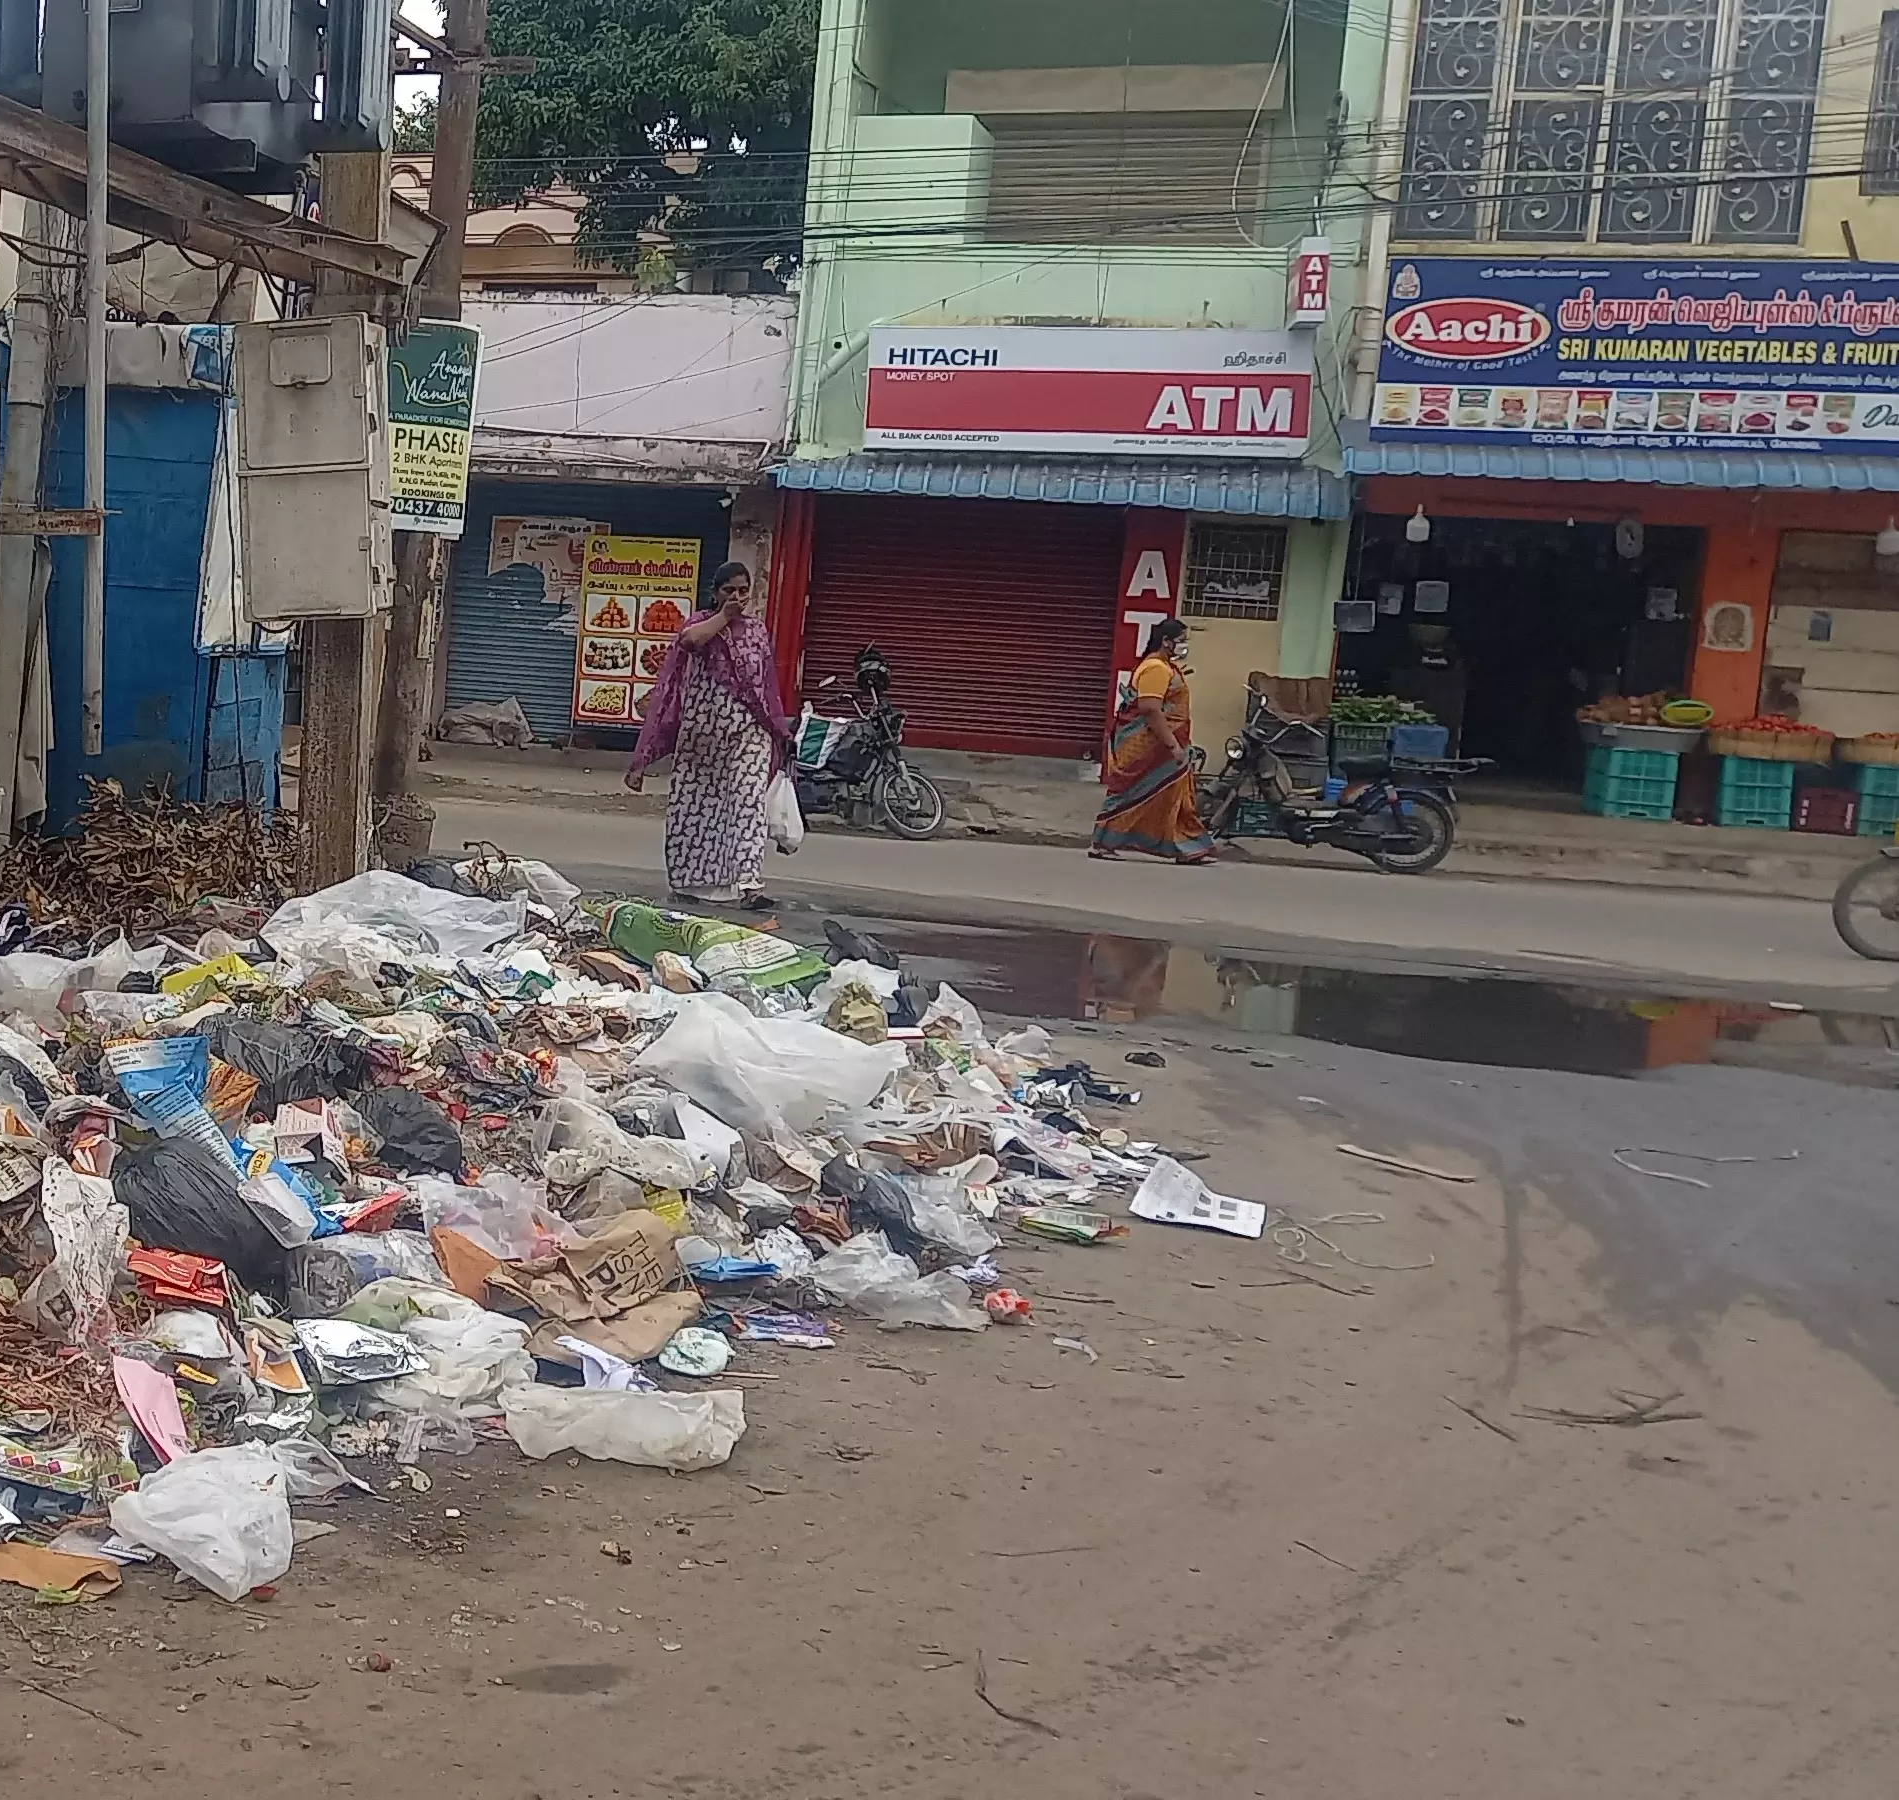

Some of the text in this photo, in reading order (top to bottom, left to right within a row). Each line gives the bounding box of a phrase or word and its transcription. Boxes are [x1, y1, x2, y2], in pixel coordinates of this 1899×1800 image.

[1303, 256, 1324, 309] ATM
[1597, 288, 1675, 334] குமரன்
[1401, 311, 1534, 343] Aachi
[888, 348, 999, 366] HITACHI
[1558, 339, 1590, 360] SRI
[1594, 339, 1690, 362] KUMARAN
[1695, 340, 1818, 364] VEGETABLES
[1822, 342, 1838, 364] &
[886, 371, 956, 382] MONEY SPOT
[1145, 385, 1293, 433] ATM
[394, 427, 457, 454] PHASE
[899, 432, 922, 440] BANK
[924, 433, 952, 441] CARDS
[954, 434, 1000, 442] ACCEPTED
[393, 452, 400, 462] 2
[404, 453, 426, 464] BHK
